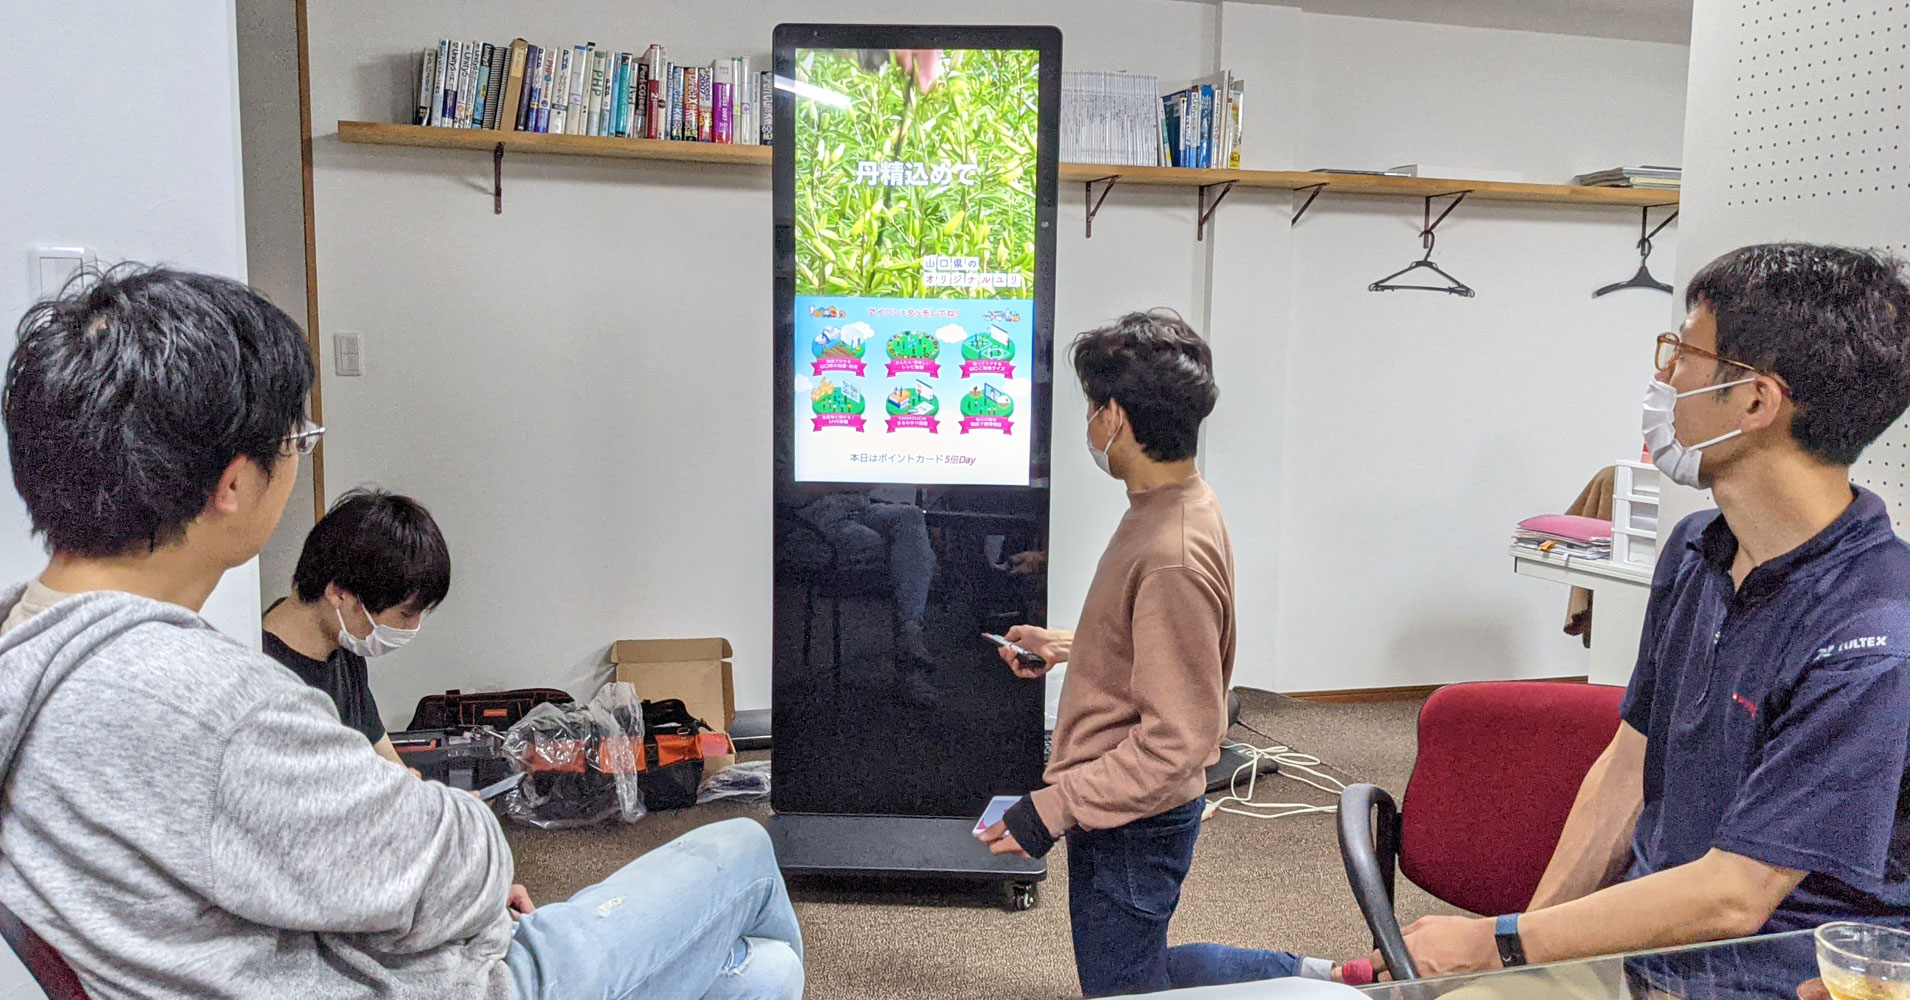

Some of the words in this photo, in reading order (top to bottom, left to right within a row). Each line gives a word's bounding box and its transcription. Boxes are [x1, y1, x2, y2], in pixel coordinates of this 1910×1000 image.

[561, 49, 569, 71] PHP
[591, 69, 603, 97] PHP
[856, 161, 978, 187] 丹精込めて
[925, 258, 977, 269] 山口県の
[925, 274, 1017, 284] オリジナルユリ
